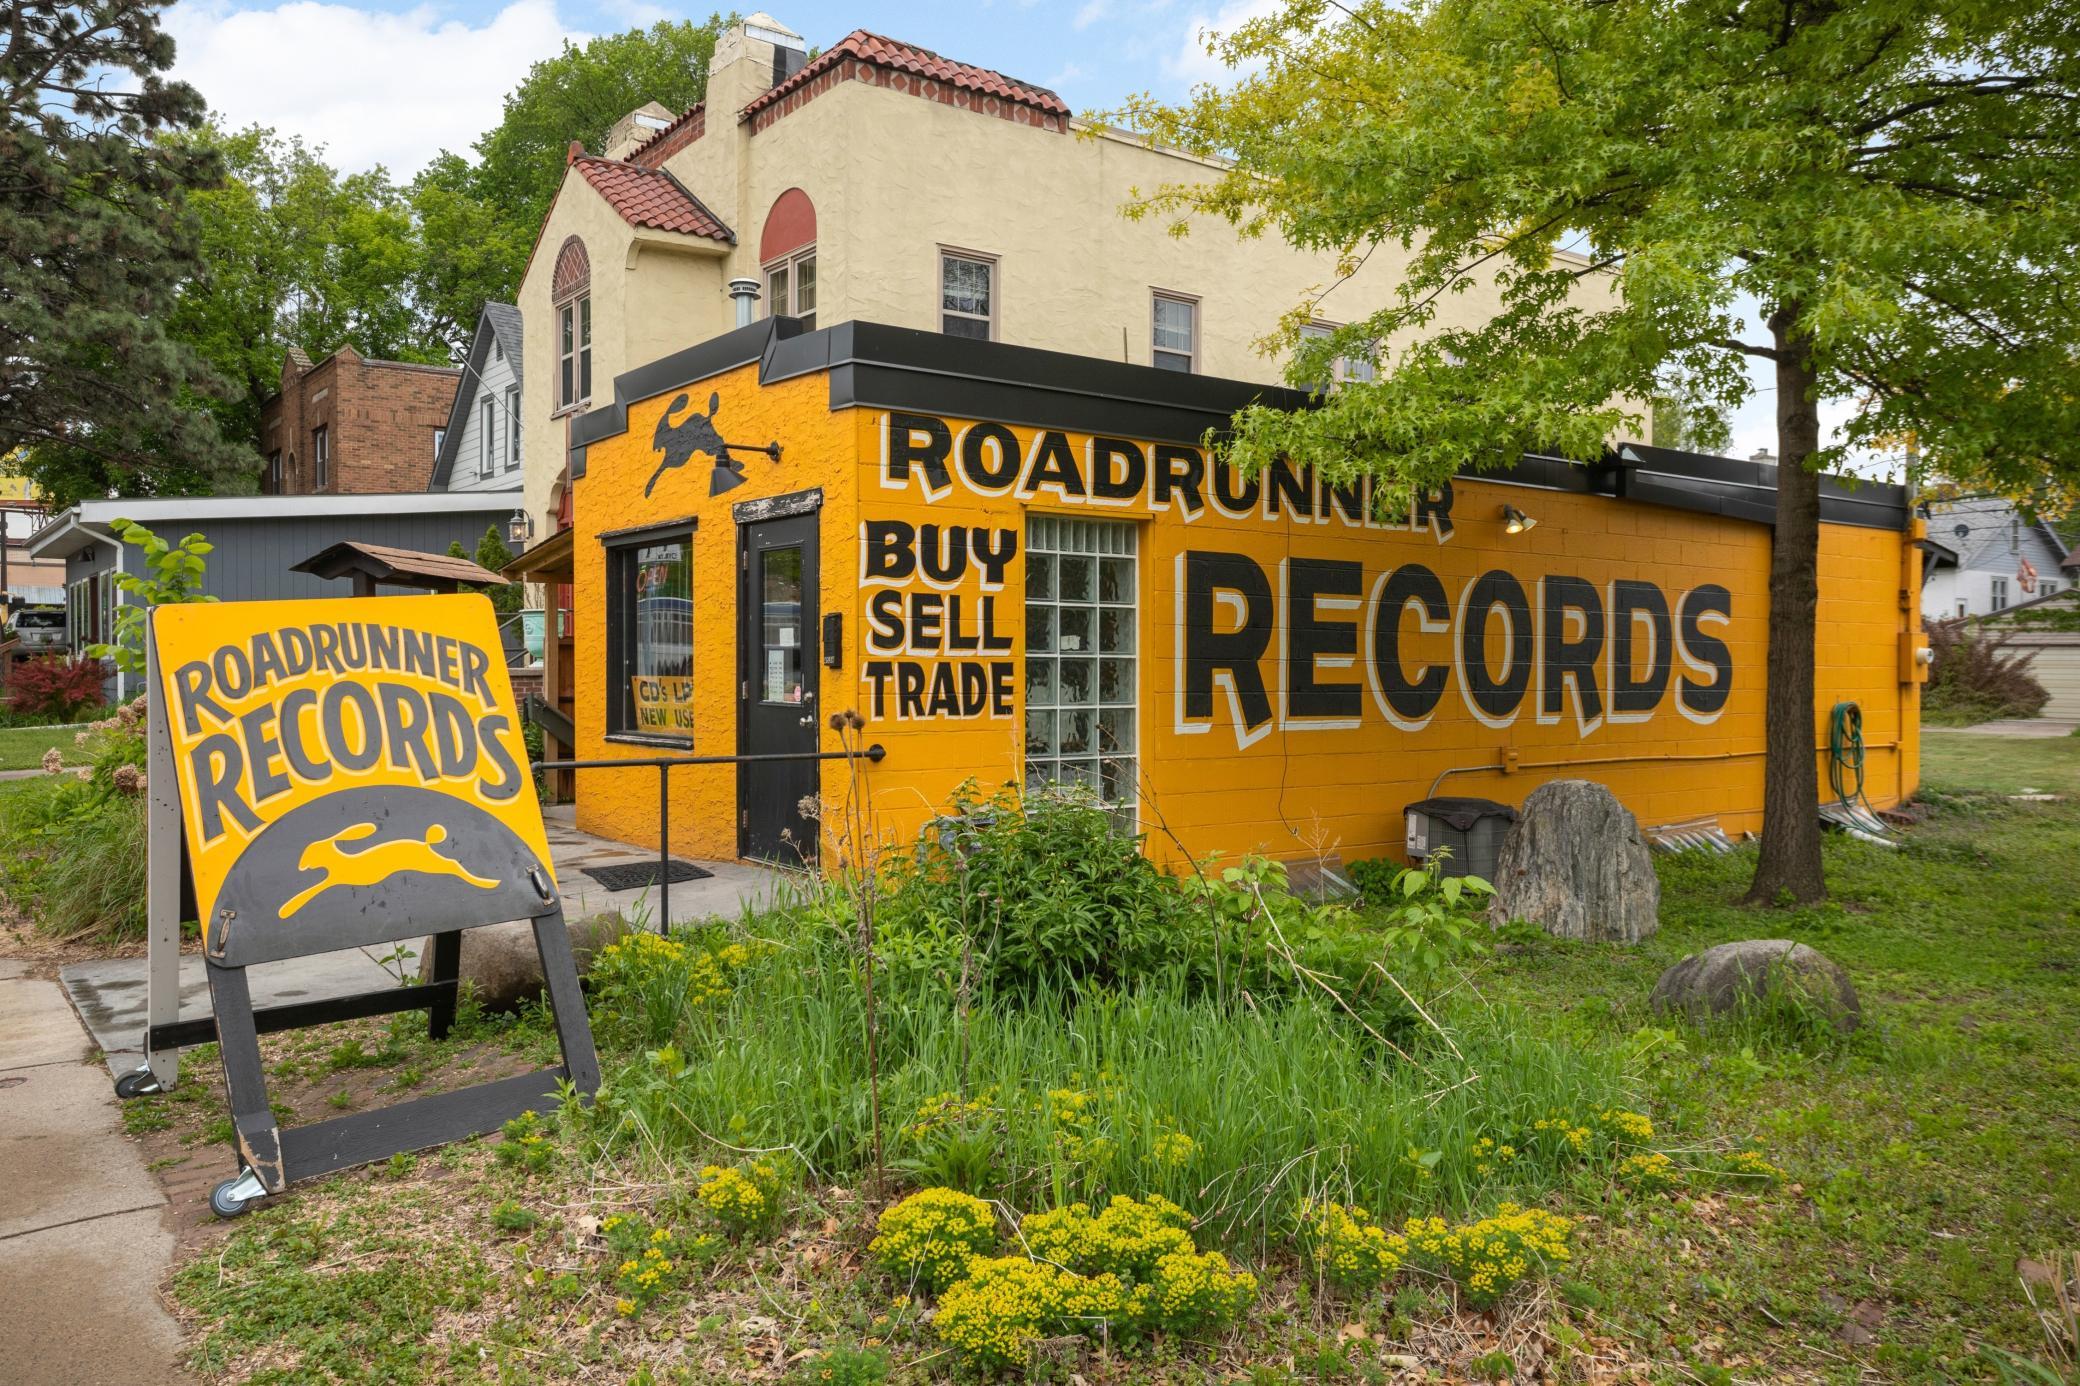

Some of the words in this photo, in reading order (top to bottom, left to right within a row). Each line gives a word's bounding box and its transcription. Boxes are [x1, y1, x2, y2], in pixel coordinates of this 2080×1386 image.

[637, 562, 668, 592] OPEN
[859, 519, 1018, 591] BUY
[865, 589, 1014, 656] SELL
[1174, 550, 1732, 748] RECORDS
[173, 622, 499, 744] ROADRUNNER
[640, 678, 668, 702] CD's
[640, 707, 667, 726] NEW
[861, 661, 1015, 721] TRADE
[186, 681, 522, 853] RECORDS
